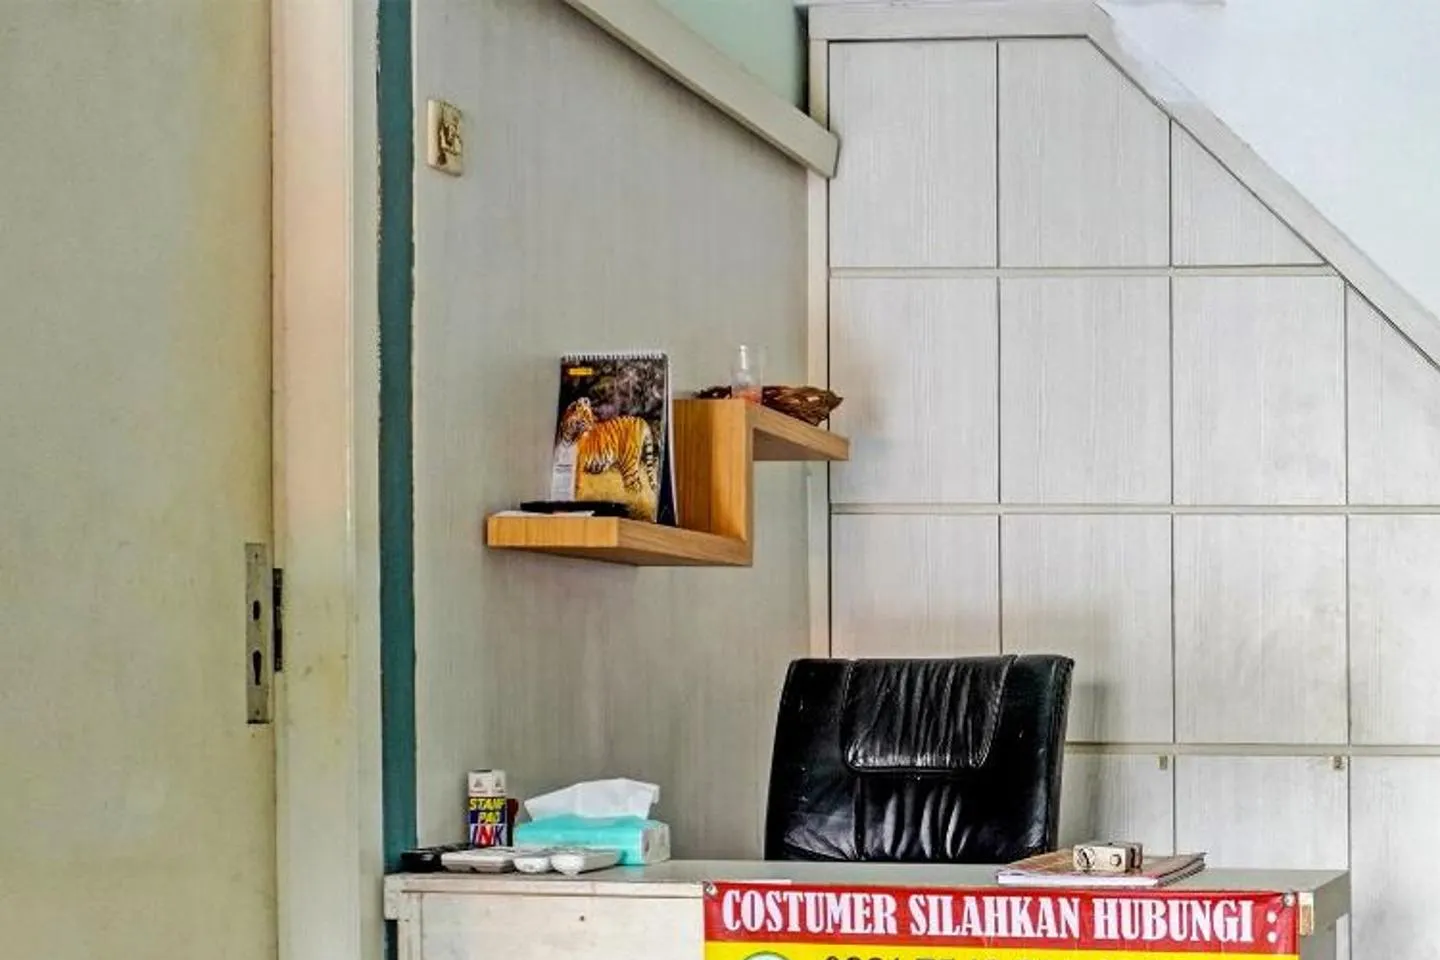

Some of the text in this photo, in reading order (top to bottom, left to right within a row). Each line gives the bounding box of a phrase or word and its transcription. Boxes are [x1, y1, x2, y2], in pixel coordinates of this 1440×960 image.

[470, 824, 507, 846] INK
[722, 889, 898, 935] COSTUMER
[908, 893, 1080, 938] SILAHKAN
[1091, 897, 1254, 942] HUBUNGI
